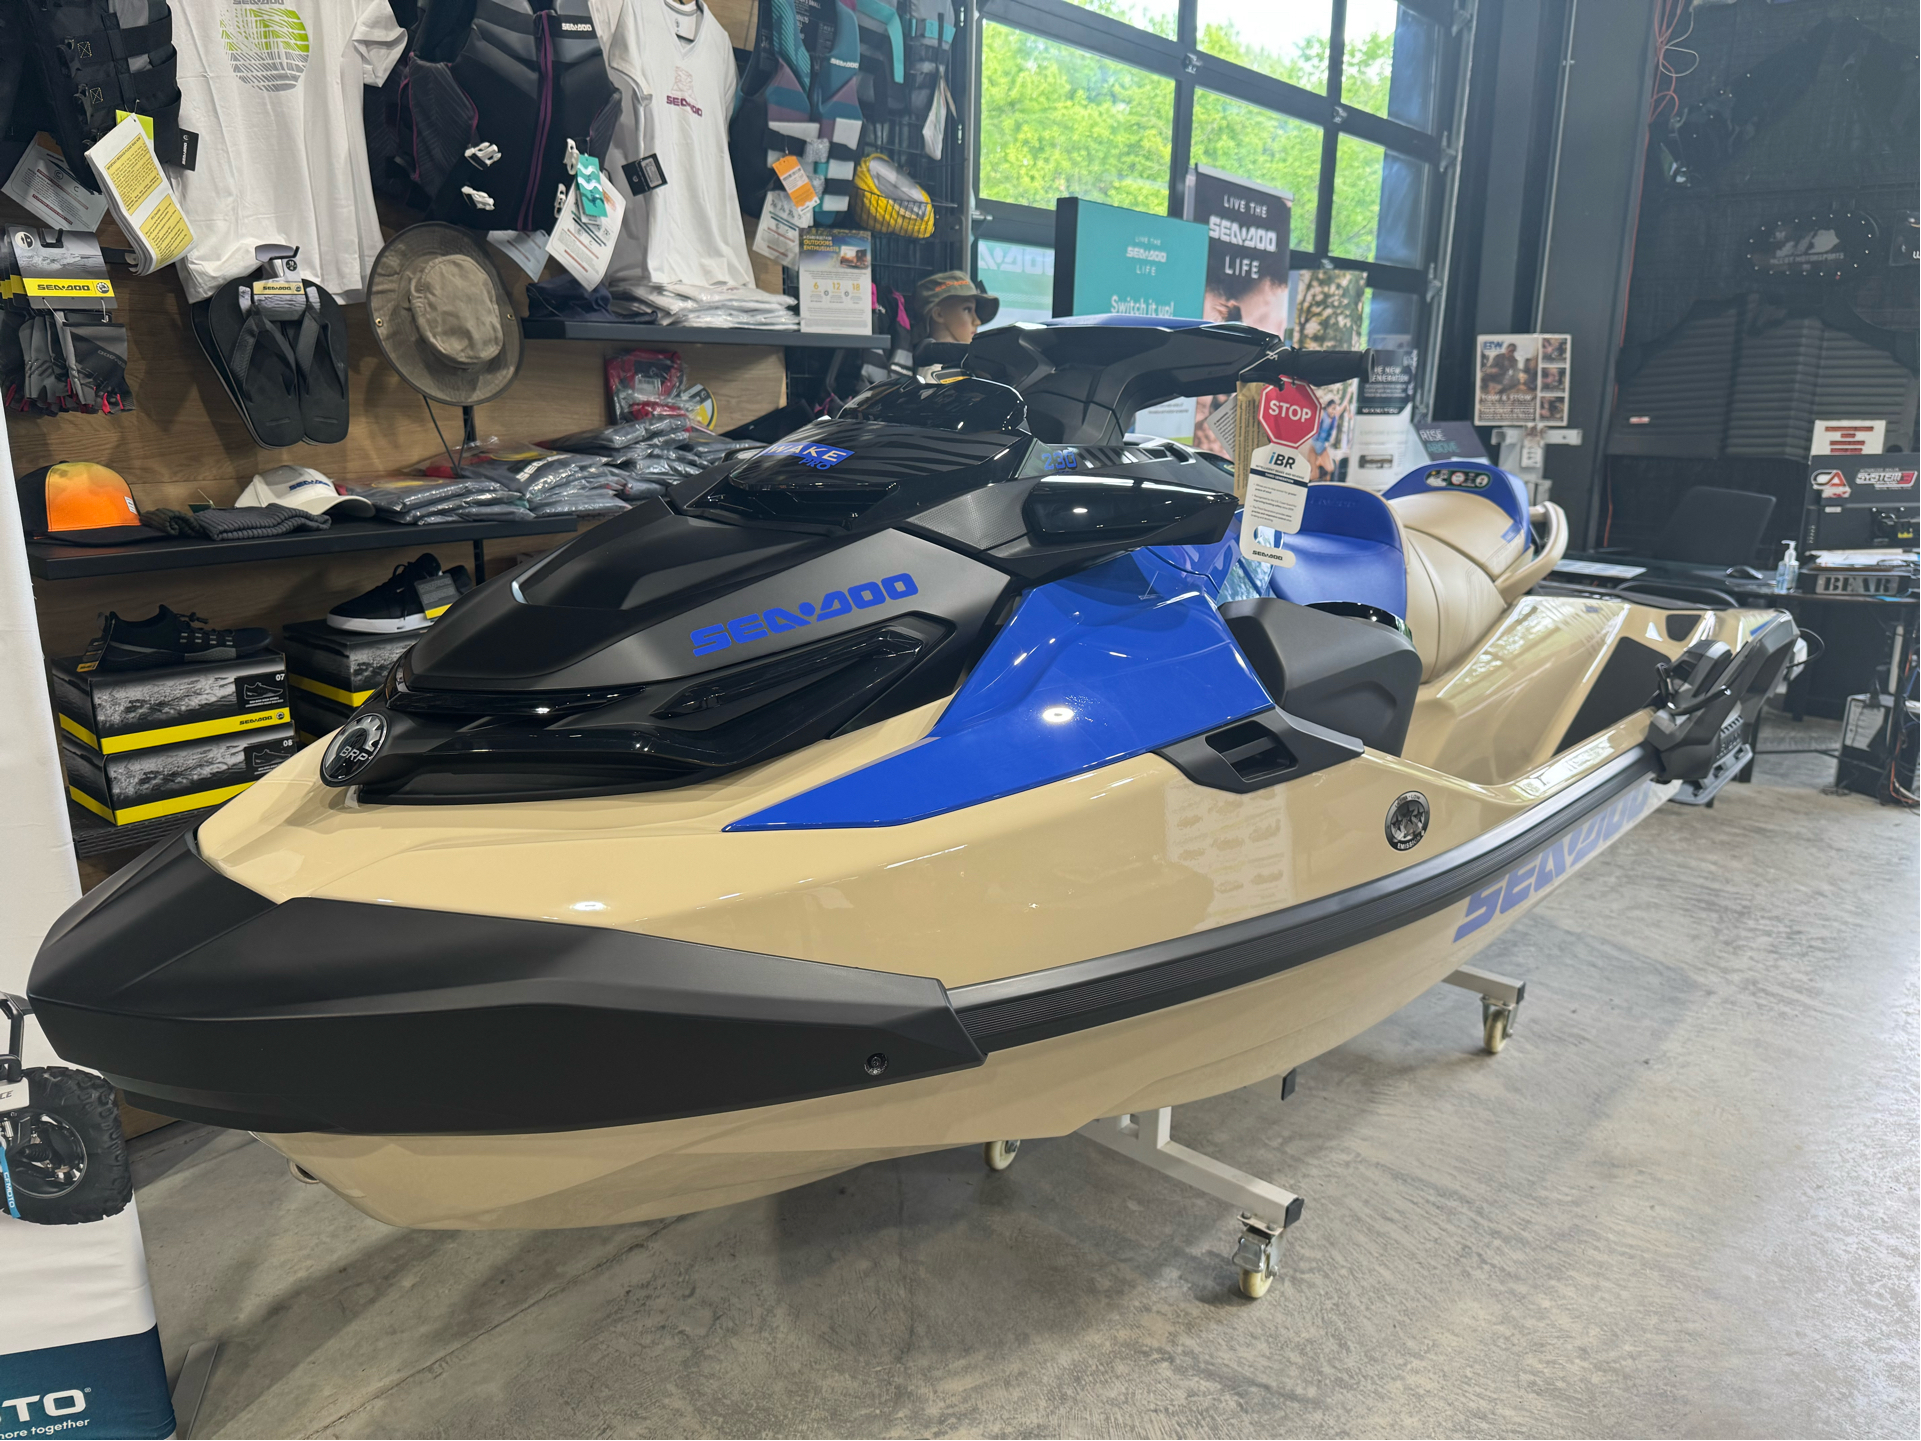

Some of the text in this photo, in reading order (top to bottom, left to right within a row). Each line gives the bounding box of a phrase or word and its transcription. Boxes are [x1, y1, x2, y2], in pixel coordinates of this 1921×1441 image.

[1223, 194, 1267, 218] LIVE THE
[1150, 238, 1161, 246] THE
[1136, 265, 1156, 276] LIFE
[1225, 255, 1260, 278] LIFE
[813, 281, 861, 291] 6 12 18
[1111, 295, 1174, 318] Switch it up!
[1372, 374, 1409, 382] ENERATION
[1268, 399, 1312, 423] STOP
[1419, 429, 1447, 441] RISE
[768, 444, 847, 462] WAKE
[1427, 441, 1460, 453] ABOVE
[799, 458, 831, 470] PRO
[1041, 450, 1077, 471] 230
[1268, 452, 1296, 470] iBR
[1823, 576, 1891, 593] BEAR
[275, 673, 285, 681] 07
[282, 739, 293, 747] 08
[340, 745, 369, 762] BRP
[3, 1171, 15, 1208] CFMOTO
[31, 1419, 90, 1436] together
